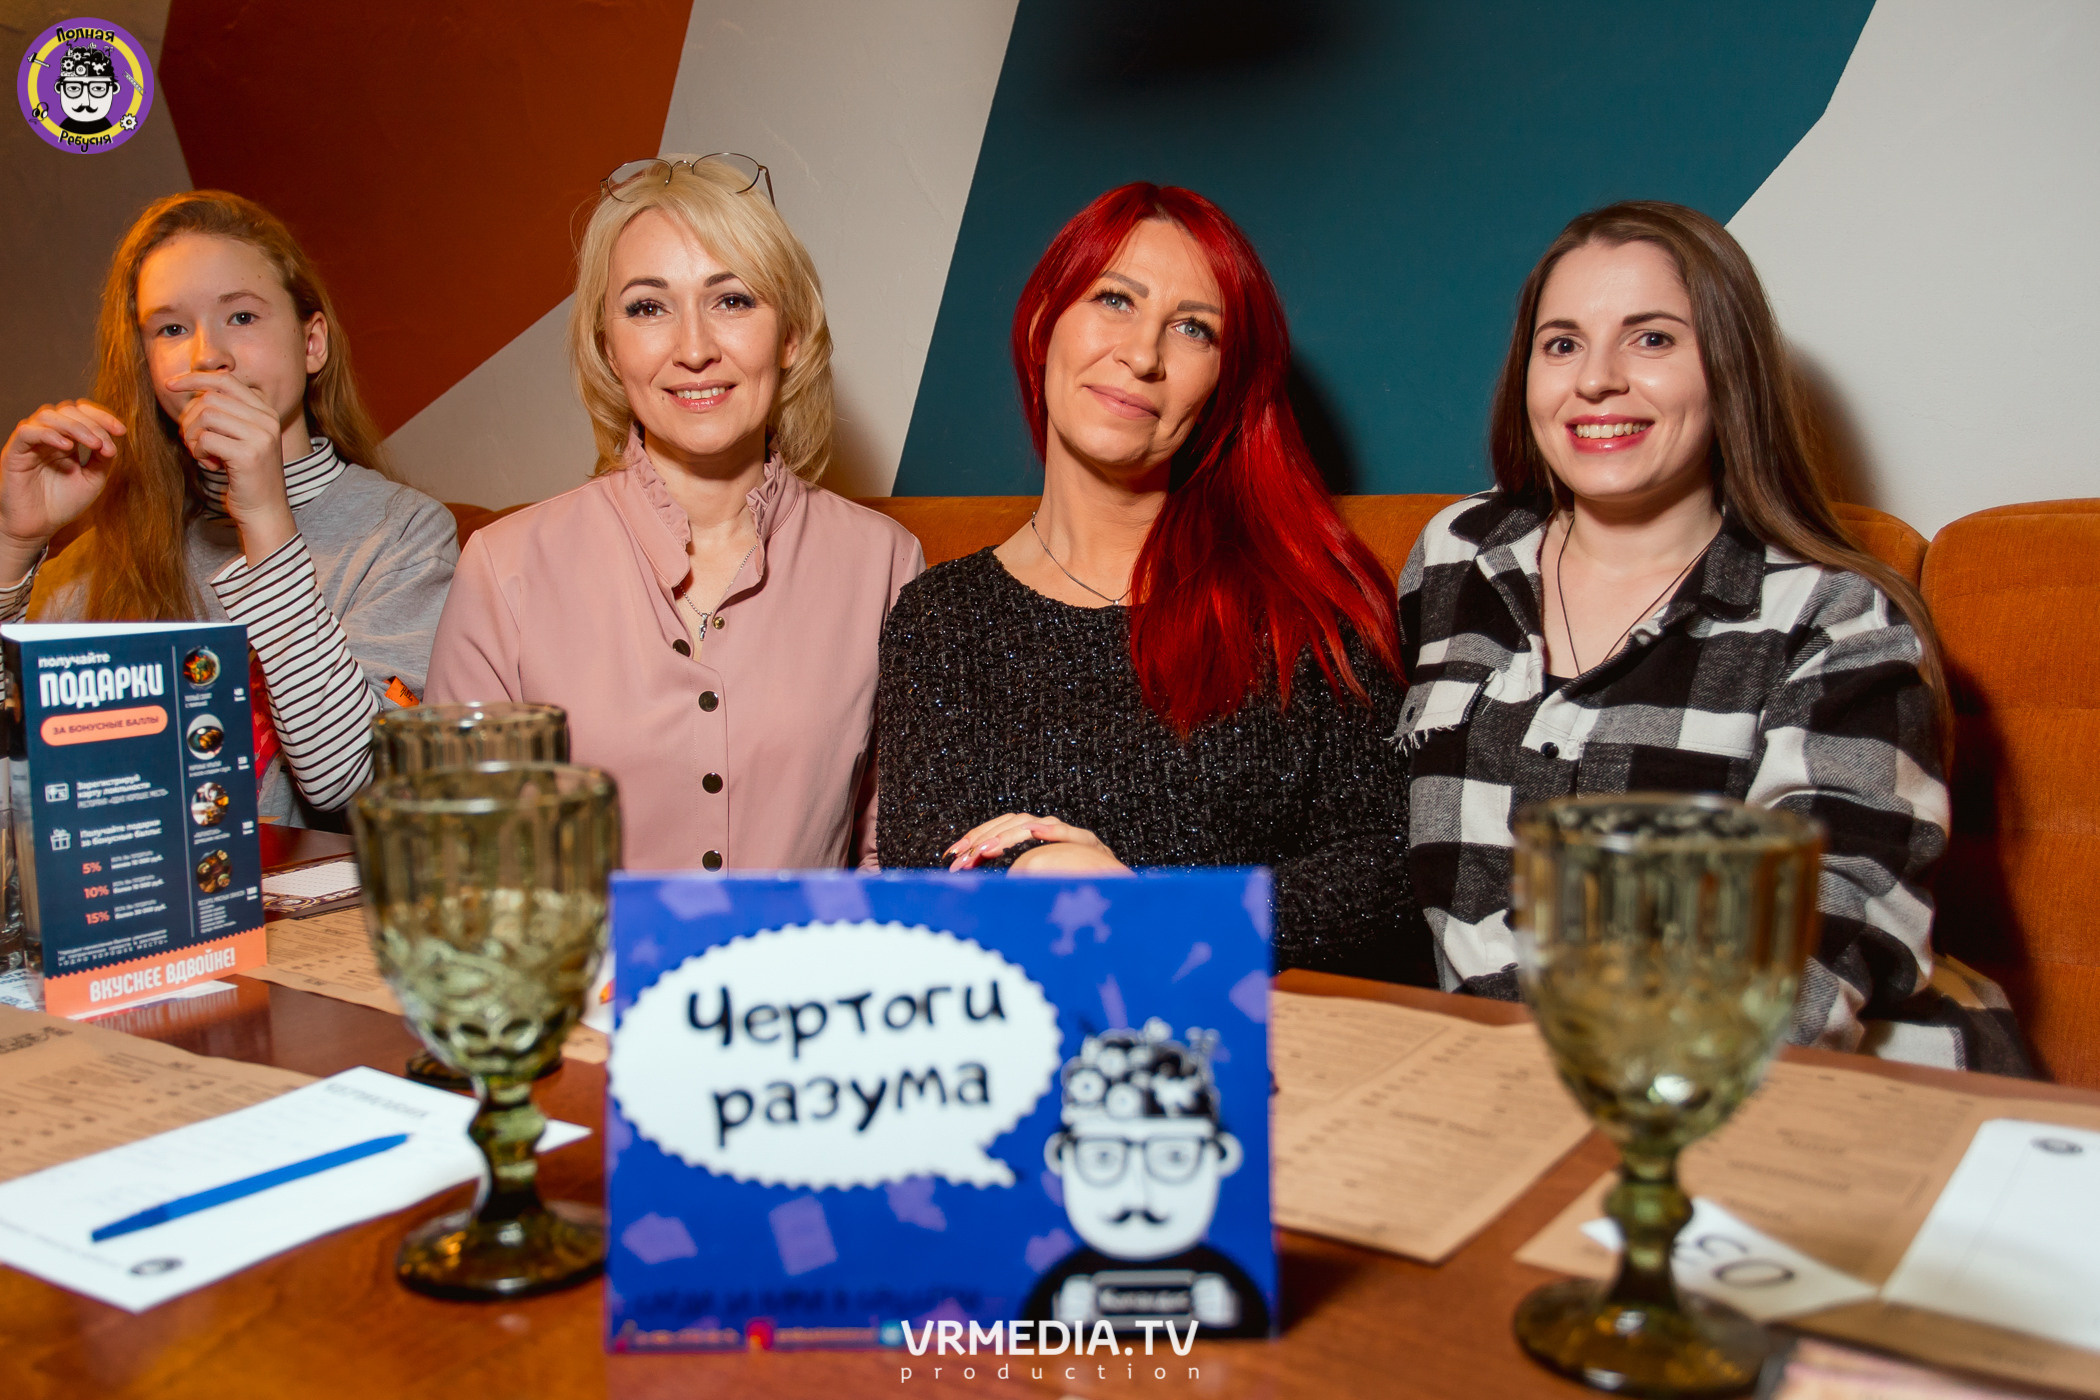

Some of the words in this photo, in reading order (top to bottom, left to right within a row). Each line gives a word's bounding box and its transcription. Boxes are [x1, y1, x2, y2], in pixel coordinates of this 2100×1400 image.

[37, 651, 111, 669] получайте
[38, 663, 165, 709] ПОДАРКИ
[52, 726, 66, 736] ЗА
[68, 719, 125, 735] БОНУСНЫЕ
[126, 715, 160, 727] БАЛЛЫ
[82, 861, 102, 874] 5%
[83, 885, 110, 899] 10%
[85, 911, 110, 926] 15%
[90, 966, 162, 1002] ВКУСНЕЕ
[166, 948, 236, 984] ВДВОЙНЕ!
[687, 978, 1007, 1060] Чертоги
[712, 1061, 990, 1149] разума
